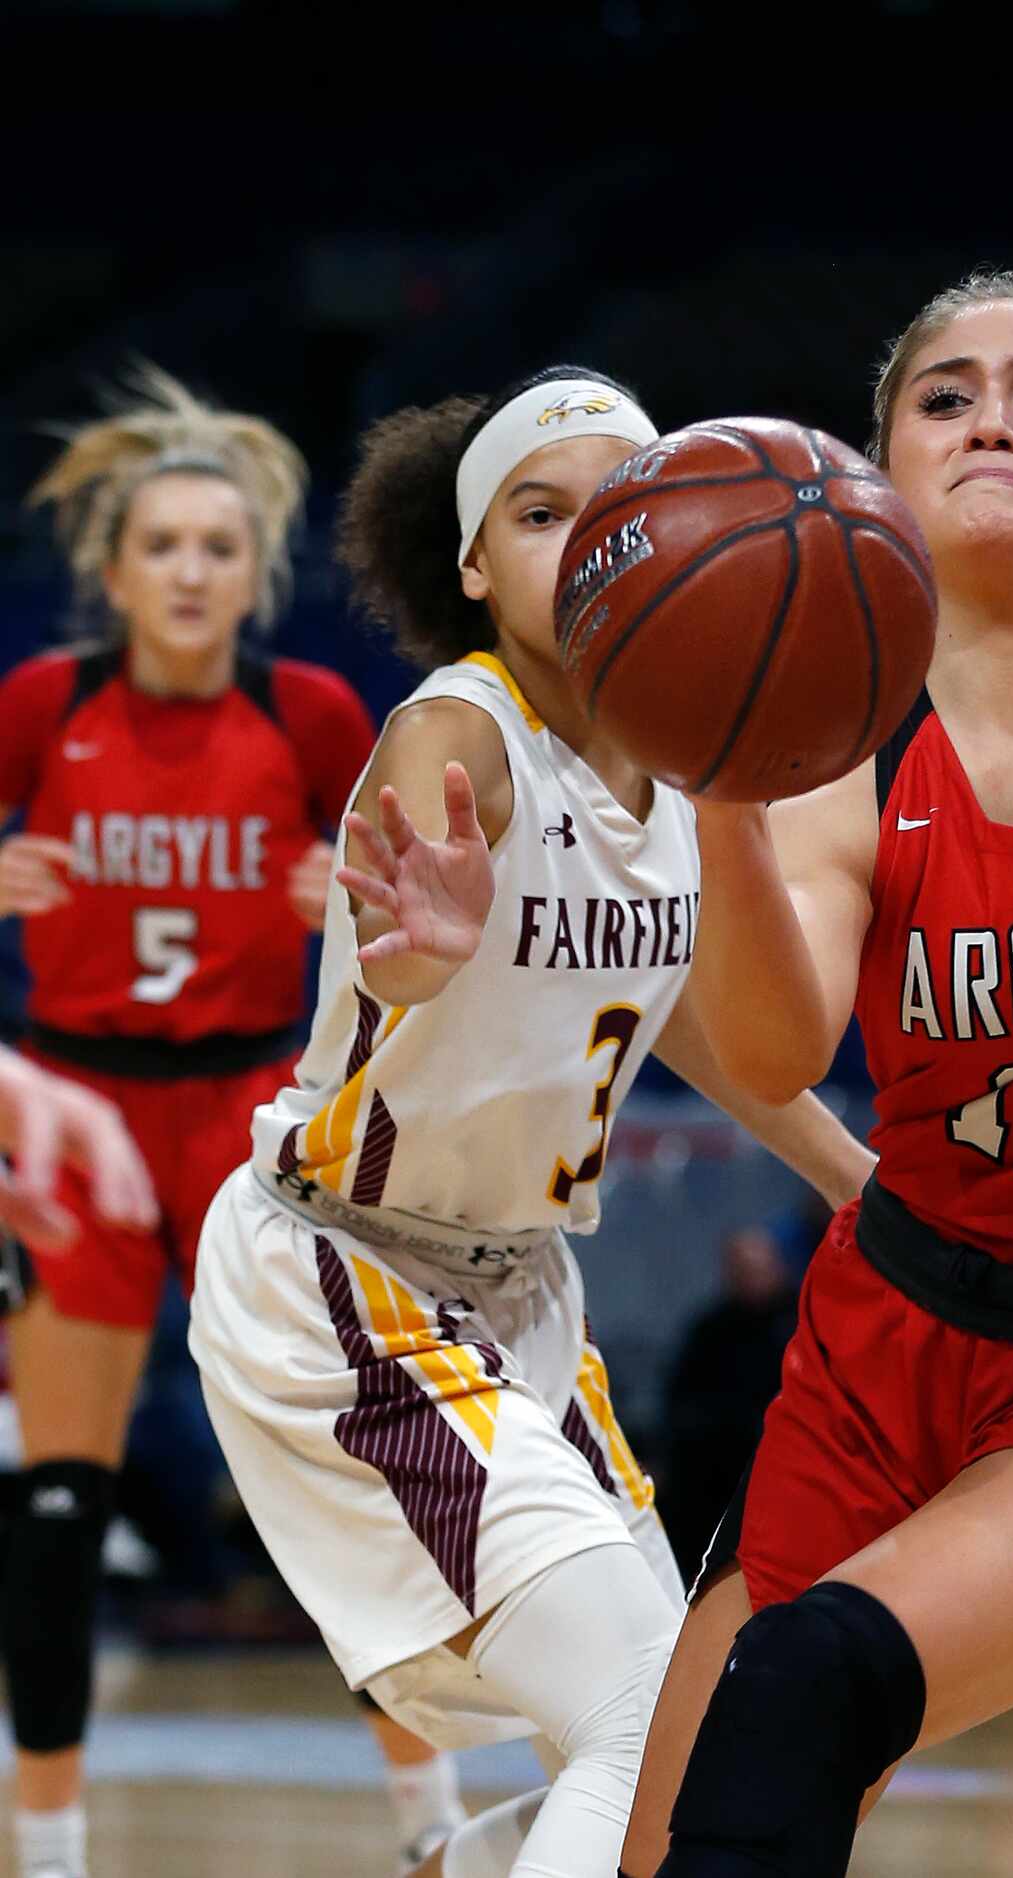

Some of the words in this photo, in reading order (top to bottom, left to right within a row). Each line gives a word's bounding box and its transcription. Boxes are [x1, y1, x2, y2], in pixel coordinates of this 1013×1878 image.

[66, 811, 270, 891] ARGYLE
[130, 908, 199, 1004] 5
[513, 891, 699, 969] FAIRFIEL
[546, 1001, 646, 1208] 3
